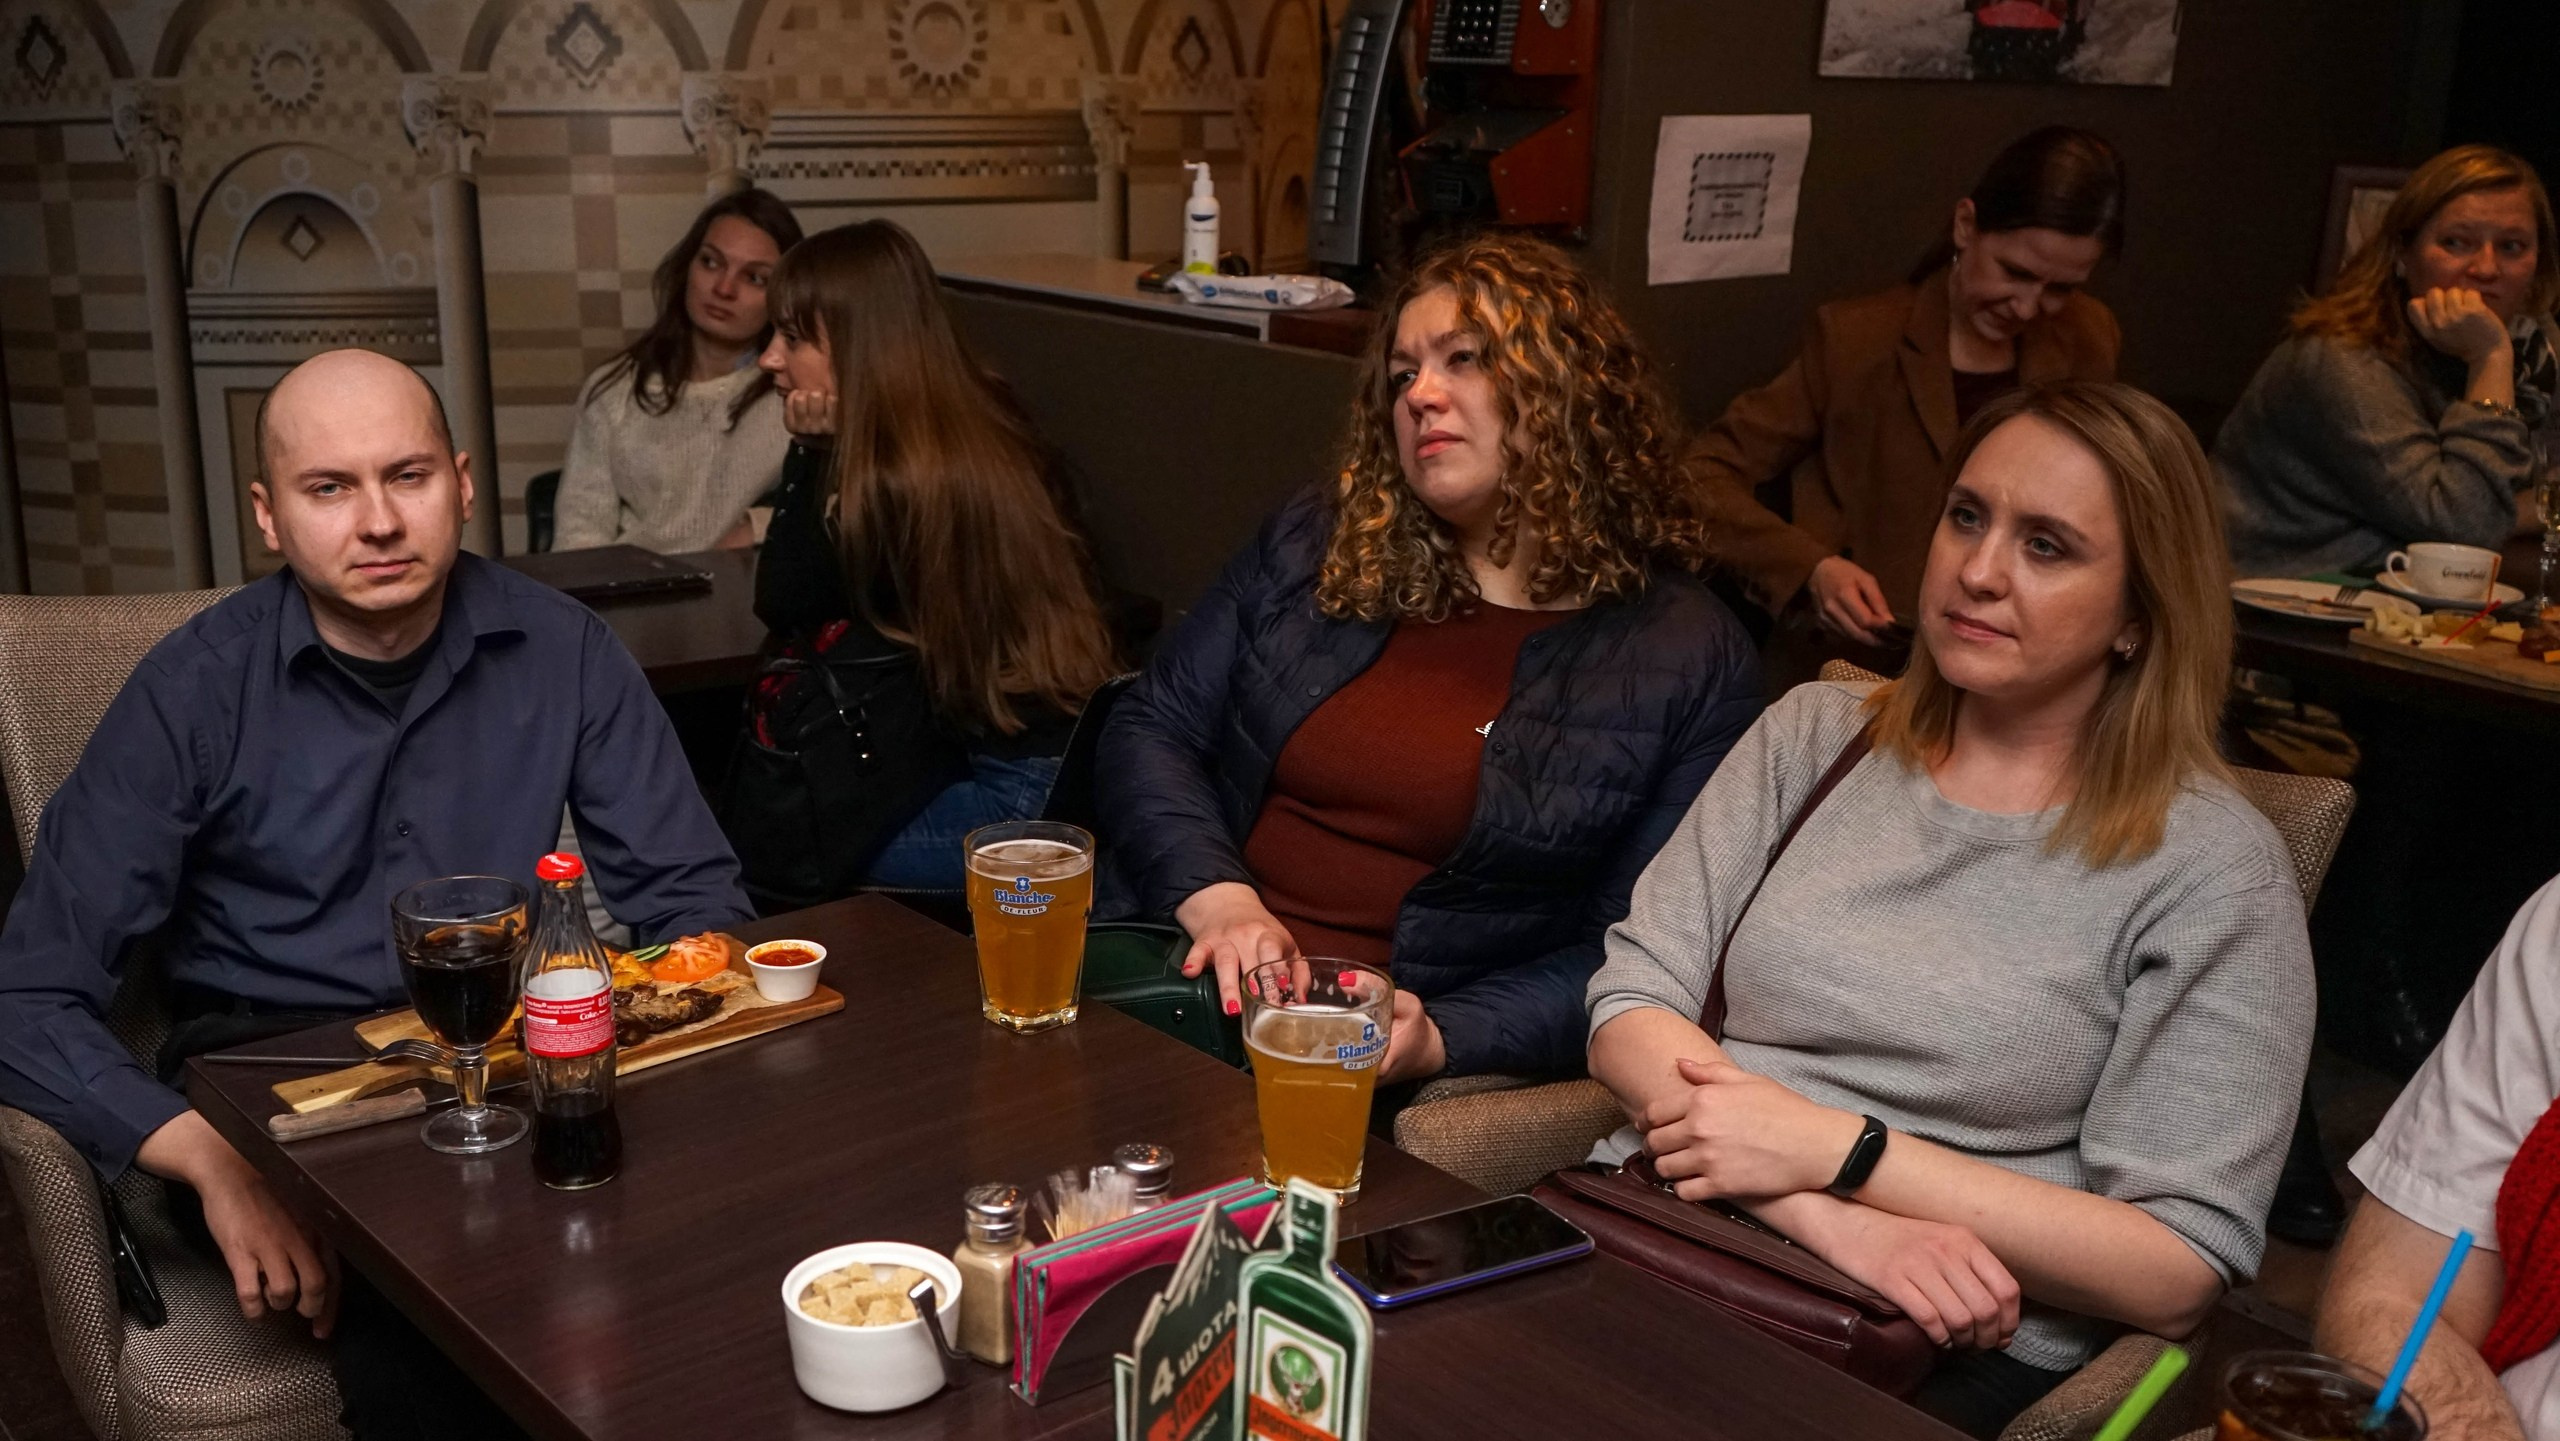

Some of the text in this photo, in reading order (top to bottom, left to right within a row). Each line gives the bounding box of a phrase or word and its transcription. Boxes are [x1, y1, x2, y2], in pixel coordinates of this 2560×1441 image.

[994, 889, 1055, 904] Blanche
[1017, 906, 1045, 915] FLEUR
[1337, 1035, 1389, 1060] Blanche
[1150, 1301, 1237, 1405] 4 ШОТА
